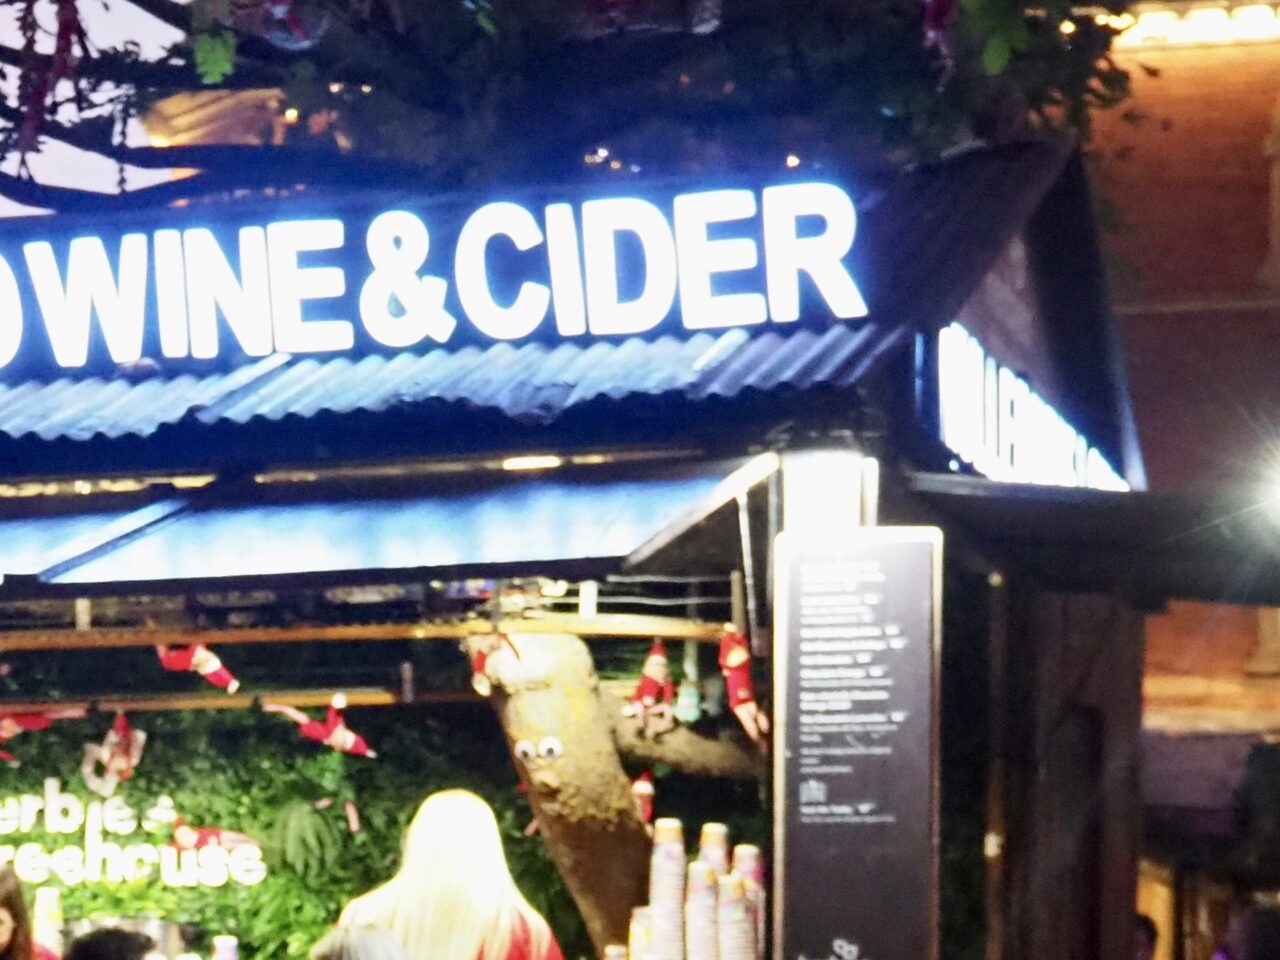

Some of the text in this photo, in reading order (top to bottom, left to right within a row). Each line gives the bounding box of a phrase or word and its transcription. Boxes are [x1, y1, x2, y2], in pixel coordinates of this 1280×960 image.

[22, 218, 354, 368] WINE
[359, 210, 457, 348] &
[454, 182, 869, 341] CIDER
